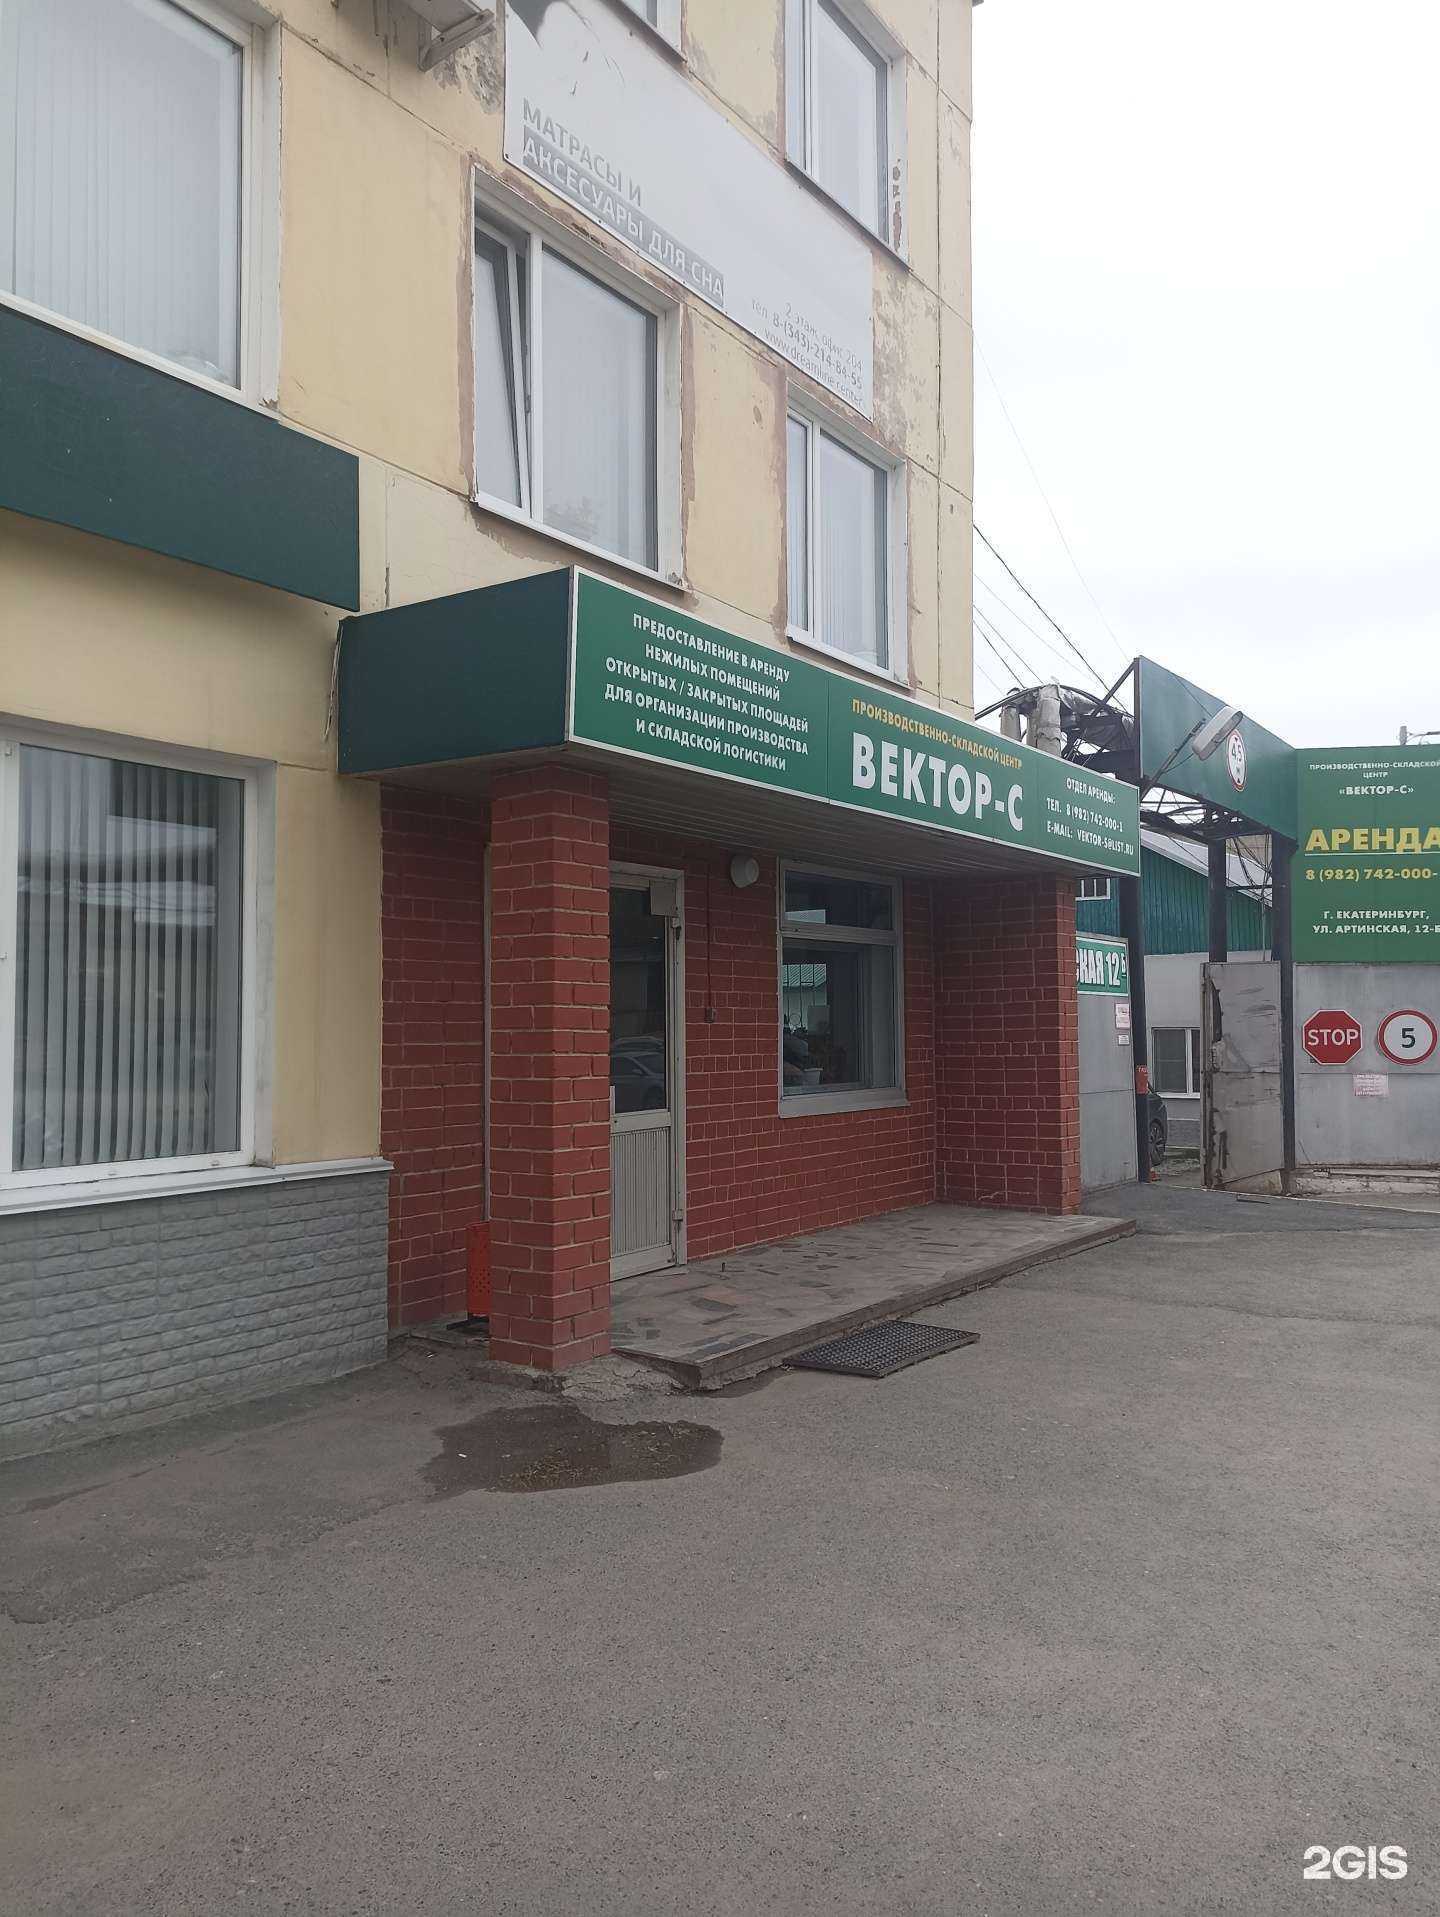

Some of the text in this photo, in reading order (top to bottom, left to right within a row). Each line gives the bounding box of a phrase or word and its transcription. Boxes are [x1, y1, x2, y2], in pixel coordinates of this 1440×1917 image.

[523, 97, 641, 206] МАТРАСЫ И
[524, 136, 723, 297] АКСЕСУАРЫ ДЛЯ СНА
[633, 613, 790, 683] ПРЕДОСТАВЛЕНИЕ В АРЕНДУ
[645, 644, 780, 701] НЕЖИЛЫХ ПОМЕЩЕНИЙ
[605, 657, 677, 691] ОТКРЫТЫХ
[687, 683, 748, 714] ЗАКРЫТЫХ
[750, 703, 808, 733] ПЛОЩАДЕЙ
[604, 684, 808, 755] ДЛЯ ОРГАНИЗАЦИИ ПРОИЗВОДСТВА
[636, 719, 786, 771] И СКЛАДСКОЙ ЛОГИСТИКИ
[852, 698, 1022, 769] ПРОИЗВОДСТВЕННО-СКЛАДСКОЙ ЦЕНТР
[852, 732, 1024, 832] ВЕКТОР-С
[1066, 777, 1087, 794] ОТДЕЛ
[1362, 771, 1388, 779] ЦЕНТР
[1339, 785, 1414, 795] «ВЕКТОР-С»
[1047, 798, 1061, 813] ТЕЛ.
[1047, 821, 1073, 838] E-MAIL:
[1305, 827, 1440, 854] АРЕНДА
[1305, 869, 1315, 880] 8
[1319, 869, 1360, 882] (982)
[1323, 910, 1430, 921] Г. ЕКАТЕРИНБУРГ,
[1313, 925, 1332, 934] УЛ.
[1335, 925, 1410, 934] АРТИНСКАЯ,
[1308, 1029, 1359, 1045] STOP
[1401, 1028, 1416, 1048] 5
